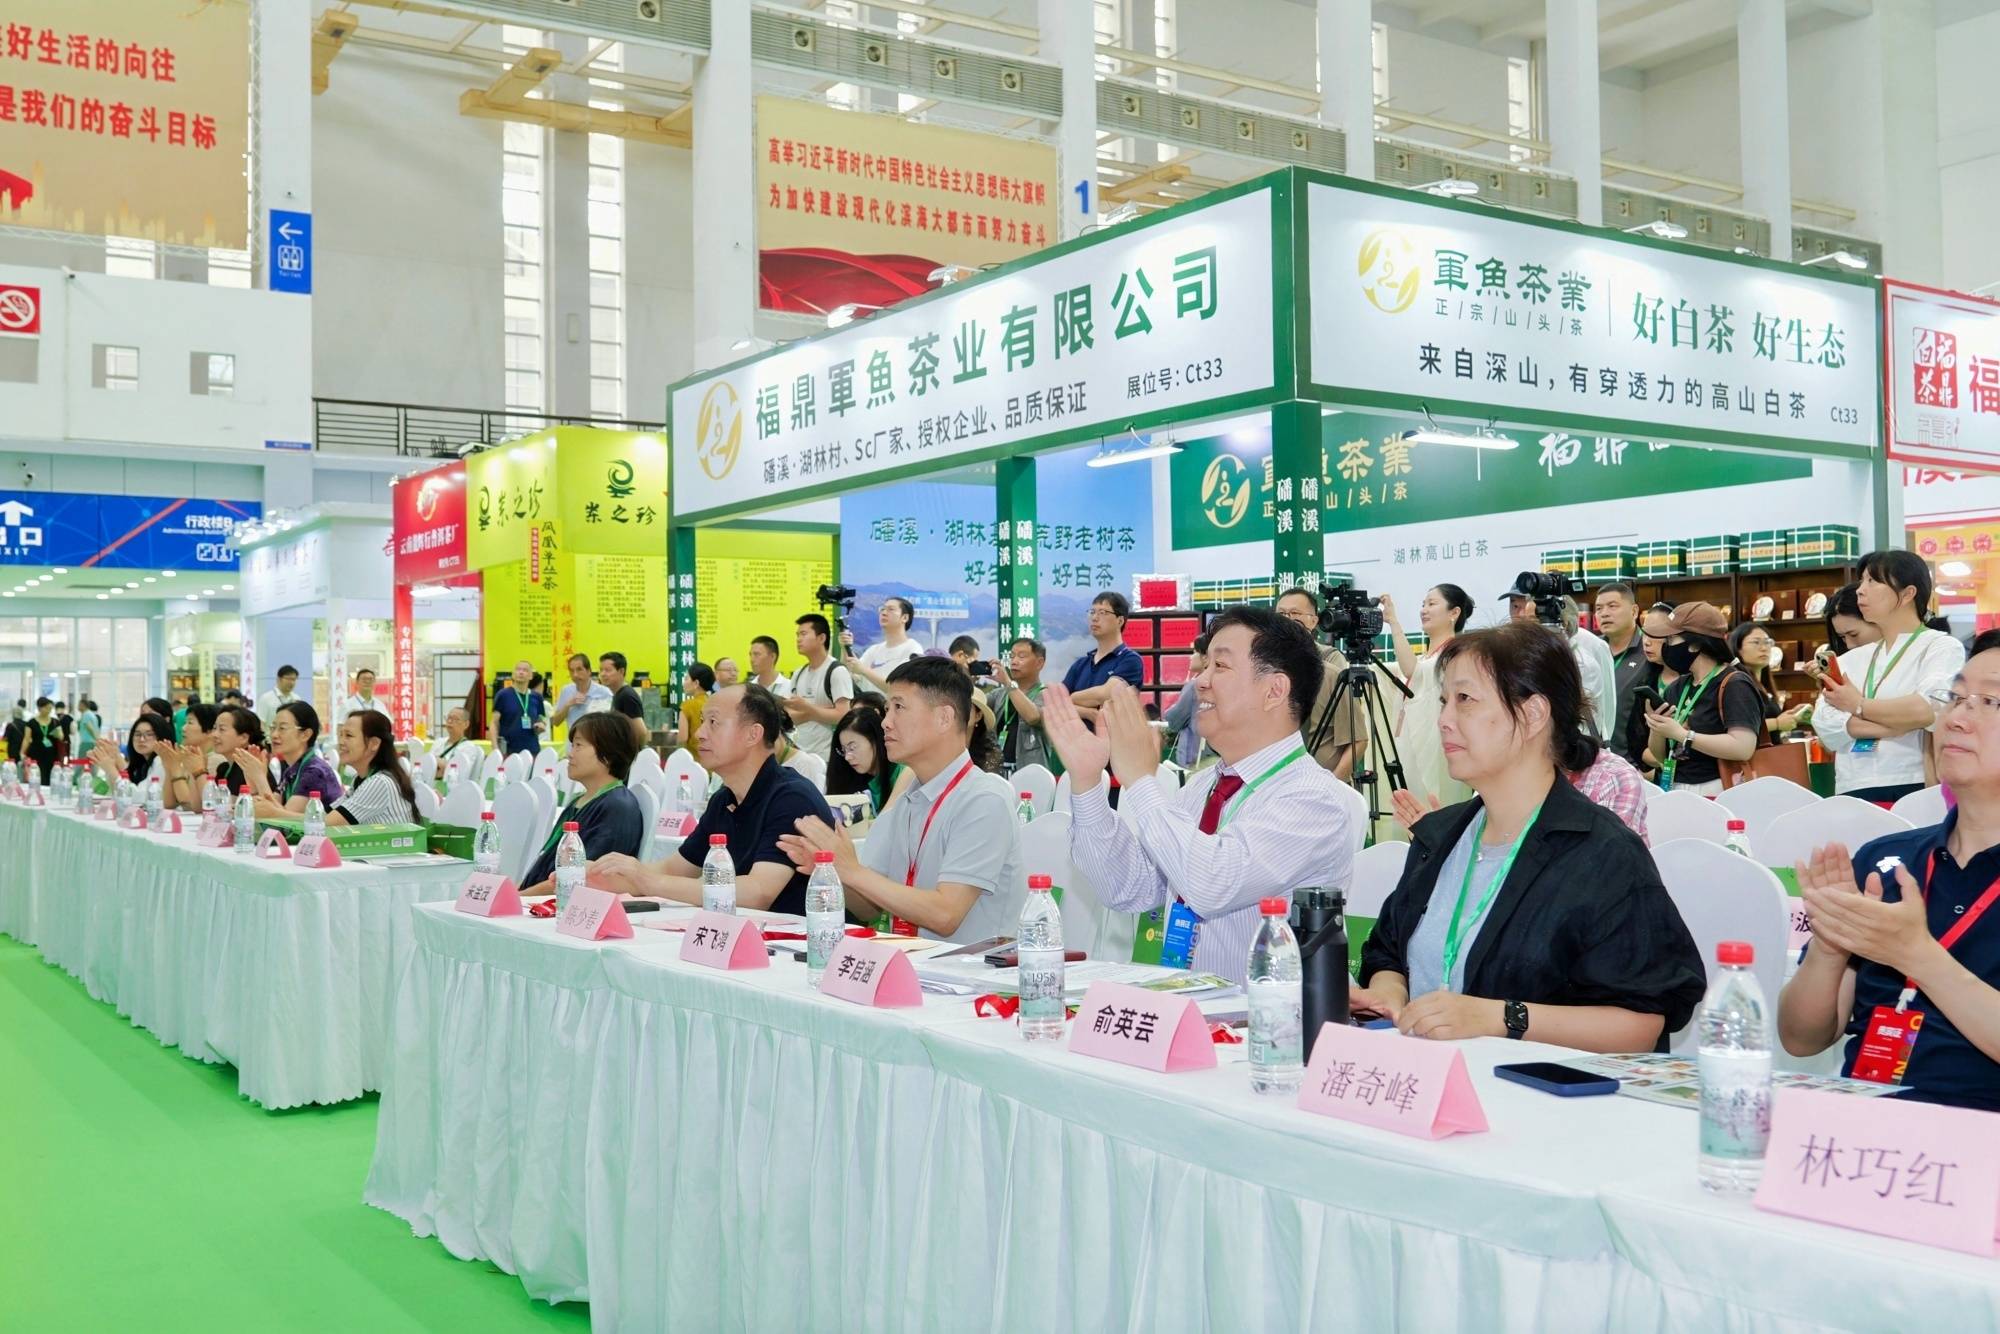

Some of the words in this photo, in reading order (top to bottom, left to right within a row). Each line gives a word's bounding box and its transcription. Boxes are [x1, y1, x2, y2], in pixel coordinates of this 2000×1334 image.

[0, 22, 176, 83] 好生活的向往
[0, 84, 216, 150] 是我们的奋斗目标
[769, 137, 1046, 206] 高举习近平新时代中国特色社会主义思想伟大旗帜
[1075, 180, 1090, 215] 1
[769, 182, 1046, 247] 为加快建设现代化滨海大都市而努力奋斗
[1631, 291, 1735, 356] 好白茶
[1751, 309, 1847, 371] 好生态
[1830, 404, 1860, 425] Ct33
[0, 547, 29, 556] XIT
[1321, 1058, 1420, 1115] 潘奇峰
[1794, 1133, 1959, 1207] 林巧红
